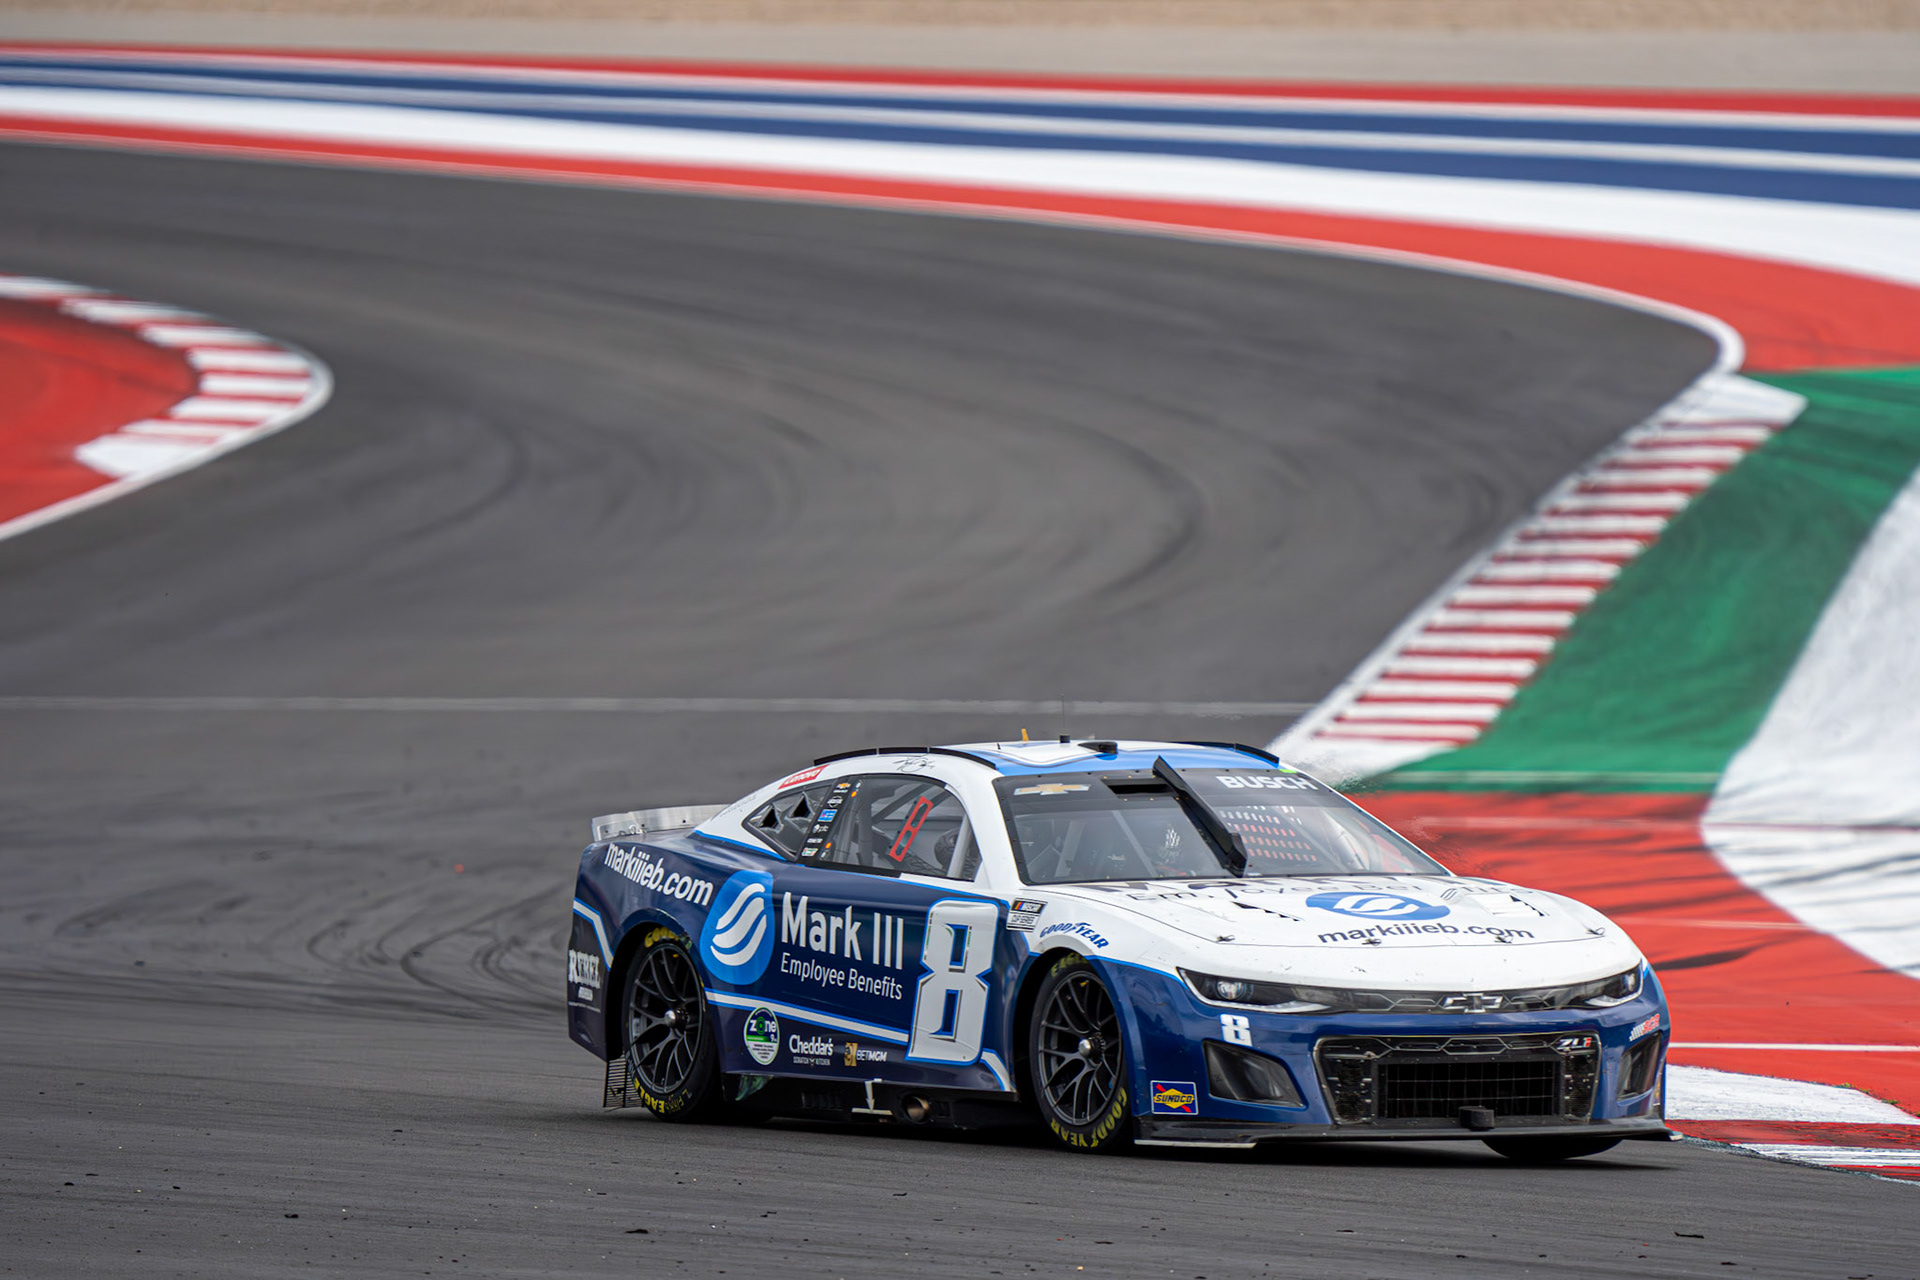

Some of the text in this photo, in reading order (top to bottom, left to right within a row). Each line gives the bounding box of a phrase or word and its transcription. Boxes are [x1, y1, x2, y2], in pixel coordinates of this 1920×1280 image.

[1215, 776, 1319, 790] BUSCH
[604, 843, 714, 906] markiiieb.com
[781, 891, 904, 970] Mark III
[1039, 922, 1110, 949] GOODYEAR
[1317, 922, 1536, 944] markiiieb.com
[781, 952, 903, 1000] Employee Benefits
[906, 898, 999, 1065] 8
[1219, 1013, 1253, 1047] 8
[789, 1034, 834, 1056] Cheddar's
[856, 1050, 888, 1062] BETMGM
[1154, 1094, 1194, 1103] SUNOCO
